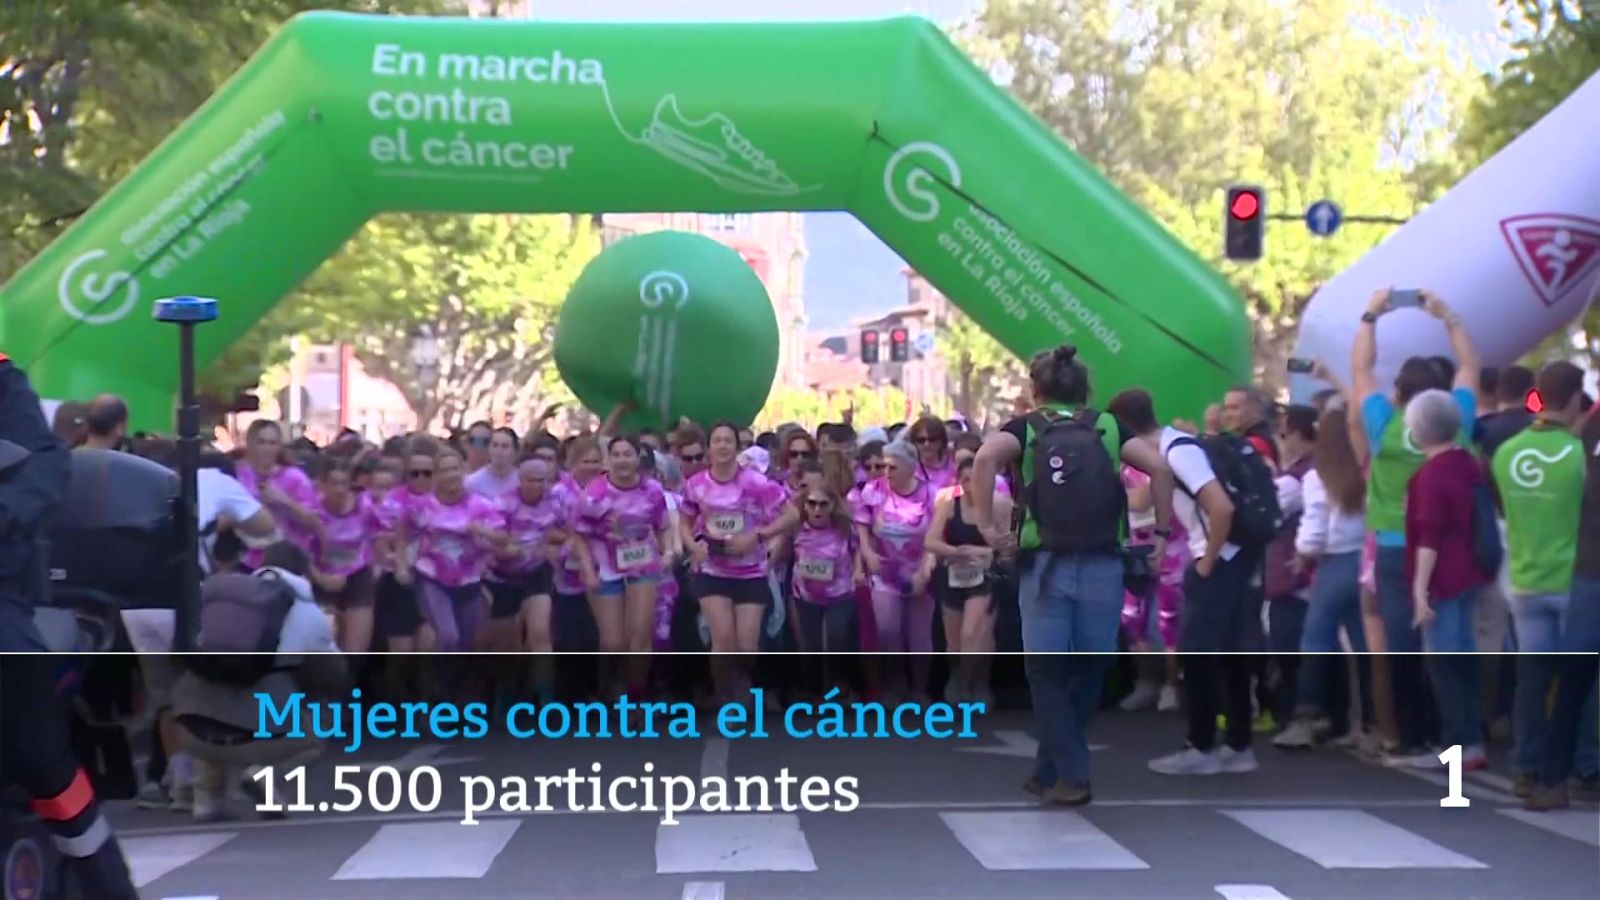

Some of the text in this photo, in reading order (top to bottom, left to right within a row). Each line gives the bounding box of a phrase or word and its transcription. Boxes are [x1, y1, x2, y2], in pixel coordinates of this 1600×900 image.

[372, 43, 603, 85] En marcha
[368, 87, 512, 125] contra
[369, 127, 574, 169] el cáncer
[953, 217, 1004, 270] contra
[1004, 267, 1023, 287] el
[938, 232, 1027, 320] en La Rioja
